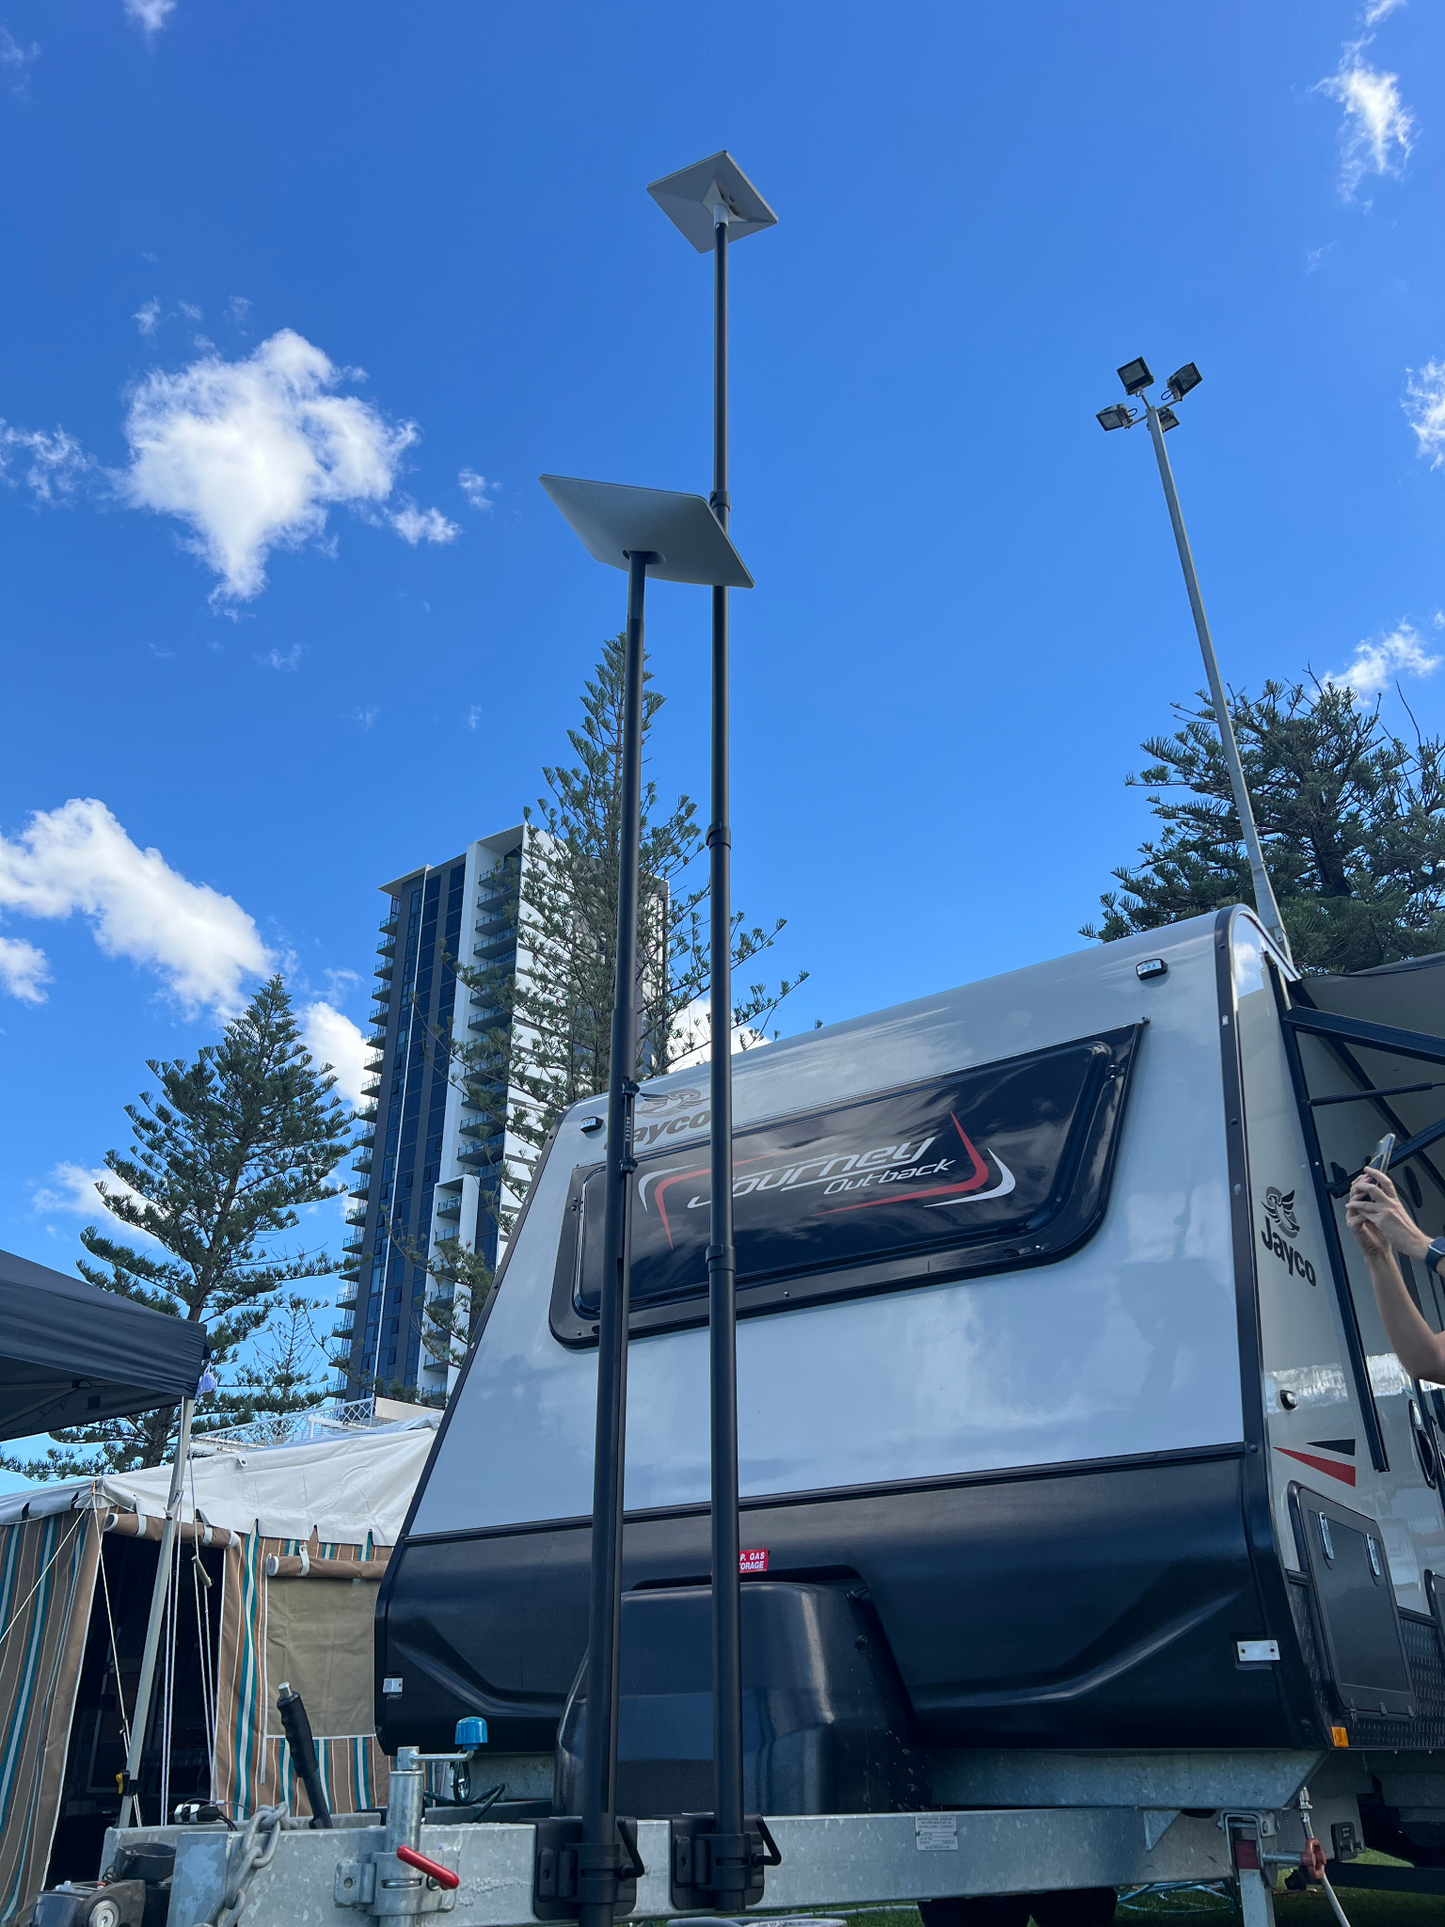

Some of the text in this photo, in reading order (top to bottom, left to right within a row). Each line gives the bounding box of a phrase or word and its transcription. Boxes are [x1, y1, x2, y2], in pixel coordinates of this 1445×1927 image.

[604, 1110, 711, 1150] ayco
[823, 1157, 956, 1196] Outback
[1261, 1216, 1316, 1287] Jayco
[739, 1561, 764, 1571] ORAGE
[749, 1551, 765, 1561] GAS
